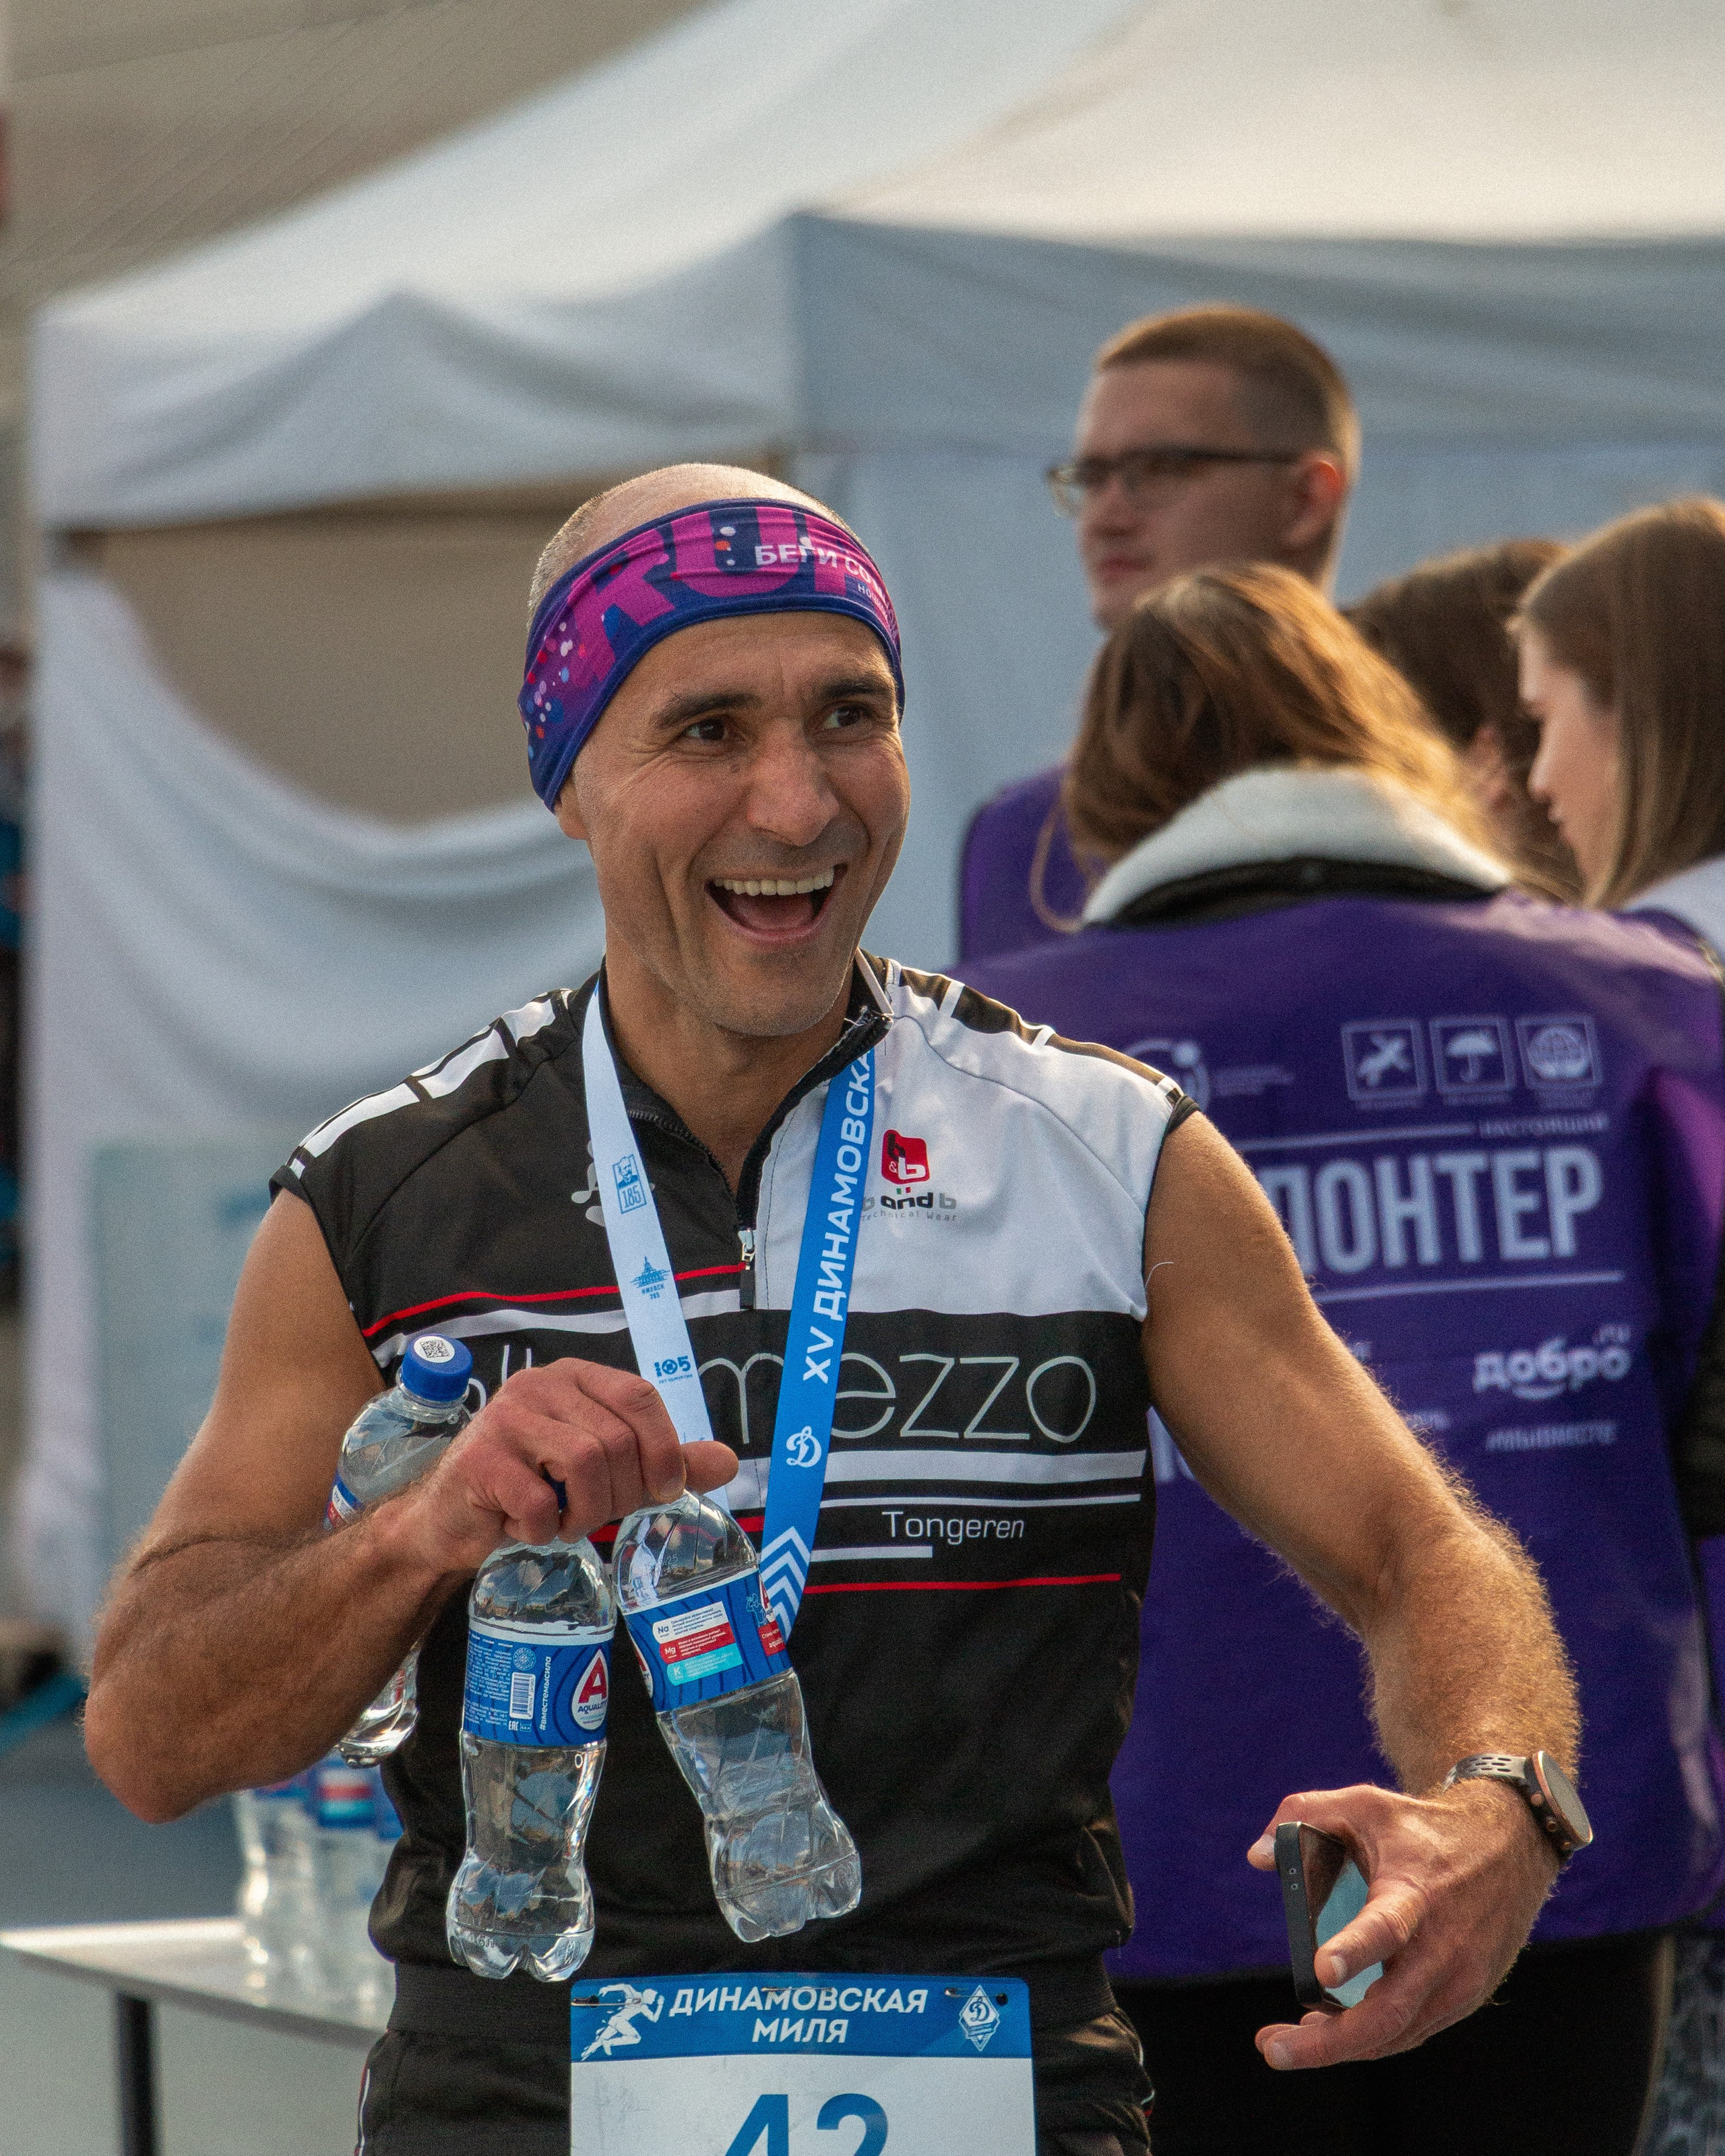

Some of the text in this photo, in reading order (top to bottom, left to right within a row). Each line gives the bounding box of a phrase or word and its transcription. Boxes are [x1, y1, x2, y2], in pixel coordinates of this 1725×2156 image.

[755, 537, 838, 567] БЕГИ
[621, 1184, 642, 1209] 185
[881, 1192, 934, 1210] and
[939, 1193, 958, 1210] b
[641, 1283, 665, 1295] ИЖЕВСК
[803, 1327, 834, 1384] XV
[1473, 1335, 1632, 1393] добро
[881, 1511, 1025, 1546] Tongeren
[658, 1625, 669, 1635] Na
[664, 1646, 677, 1655] Mg
[538, 1656, 552, 1731] #вместемысила
[669, 1987, 929, 2017] ДИНАМОВСКАЯ
[751, 2019, 849, 2043] МИЛЯ
